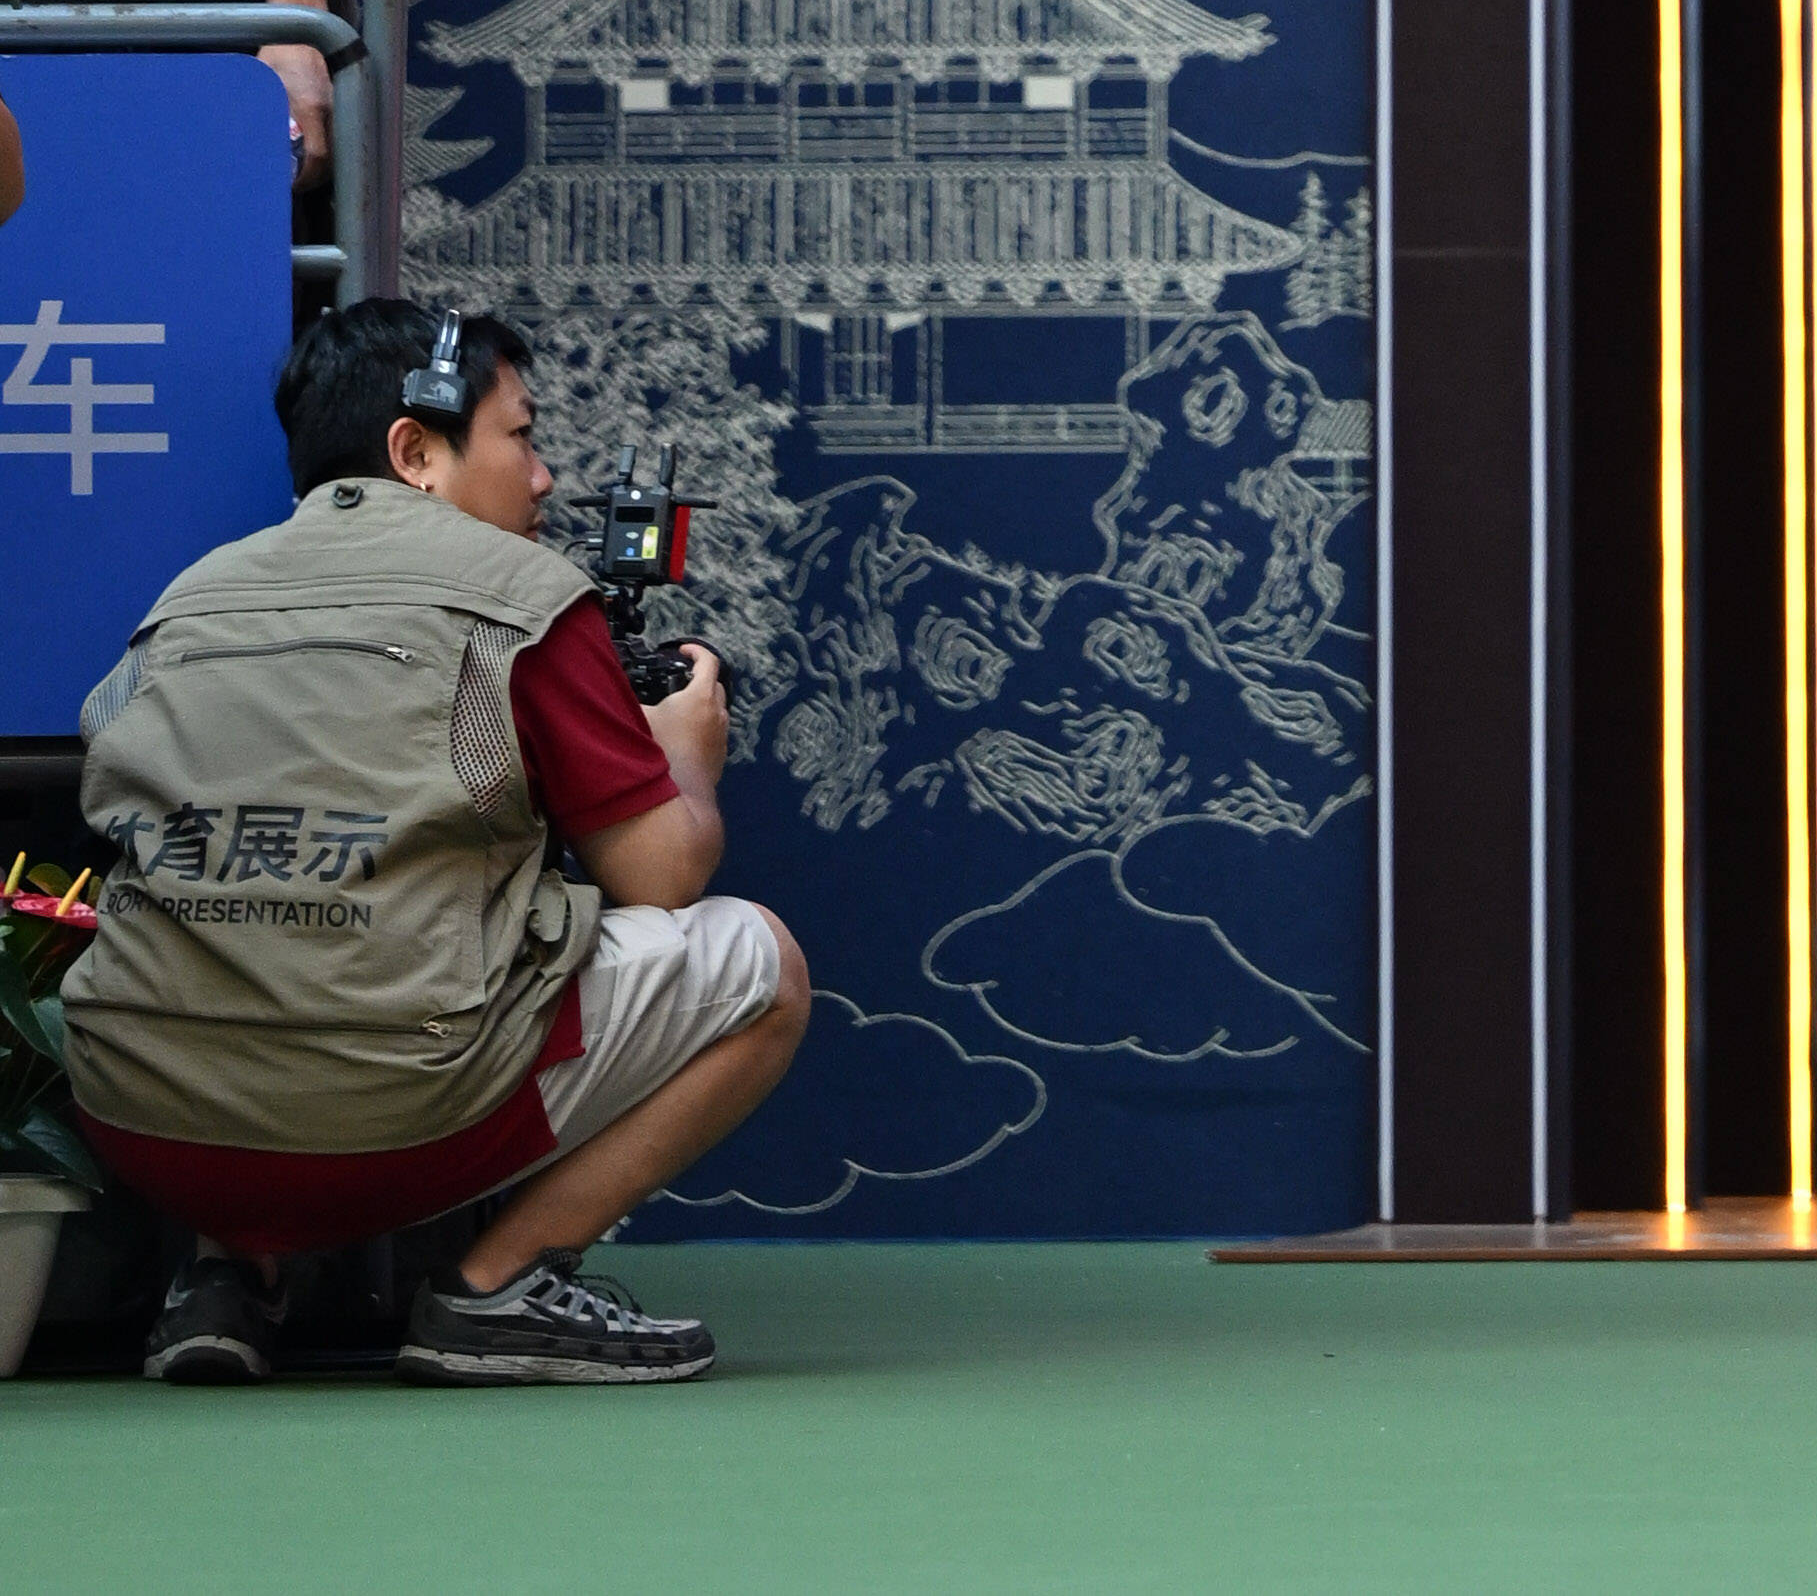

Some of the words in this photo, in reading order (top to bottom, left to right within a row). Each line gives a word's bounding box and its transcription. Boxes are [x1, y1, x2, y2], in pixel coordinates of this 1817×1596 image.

[0, 299, 169, 496] 车
[104, 801, 389, 882] 体育展示
[161, 897, 372, 929] PRESENTATION
